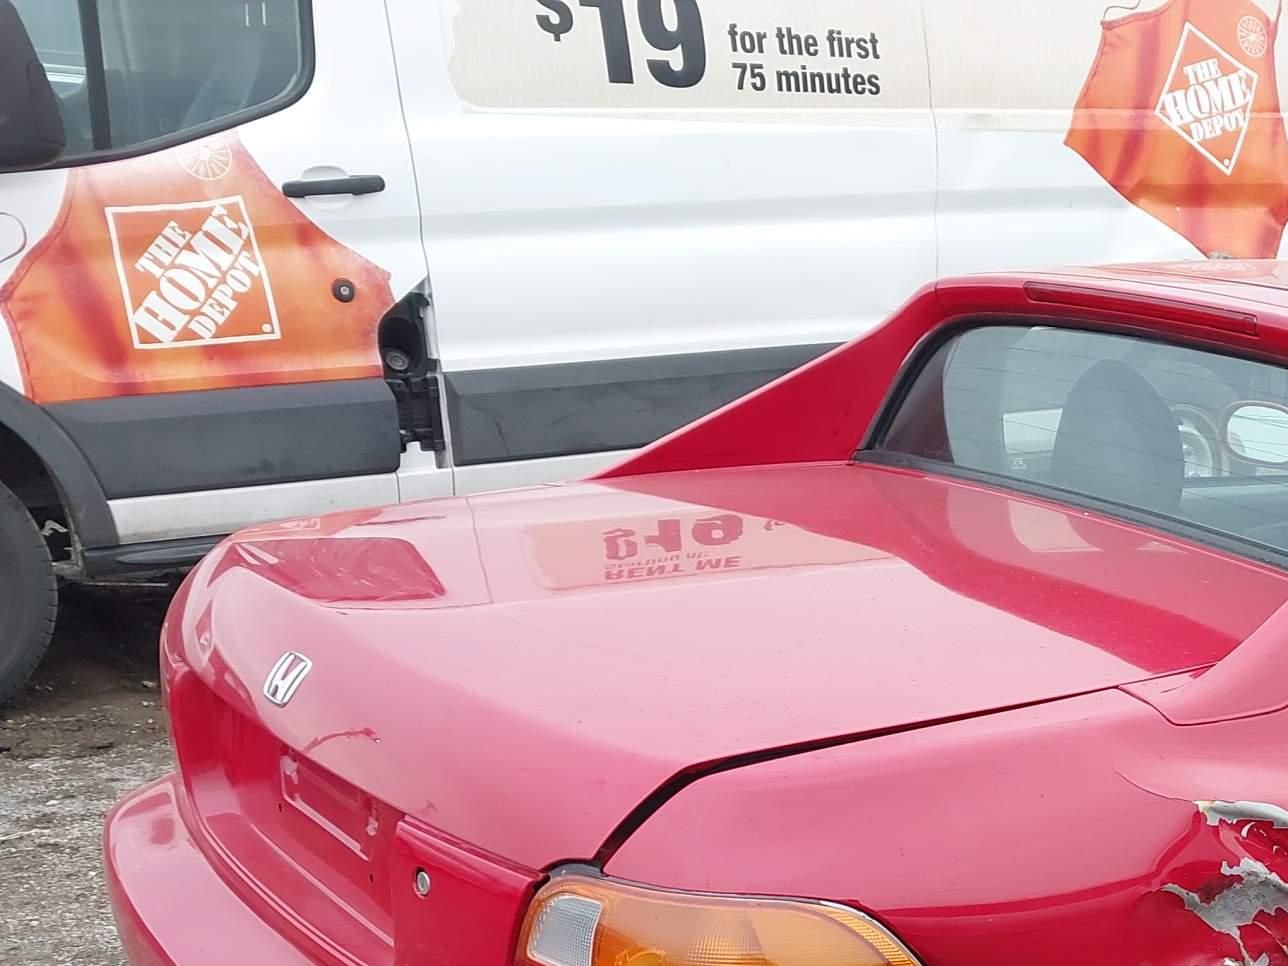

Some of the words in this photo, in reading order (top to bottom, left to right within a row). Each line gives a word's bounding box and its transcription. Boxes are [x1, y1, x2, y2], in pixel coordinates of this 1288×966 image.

[728, 23, 767, 54] for
[775, 27, 819, 57] the
[826, 30, 881, 60] first
[731, 63, 766, 91] 75
[775, 65, 881, 95] minutes
[1183, 58, 1222, 85] THE
[1162, 70, 1252, 125] HOME
[1189, 107, 1246, 142] DEPOT
[134, 220, 192, 279] THE
[134, 205, 250, 343] HOME
[187, 250, 261, 339] DEPOT
